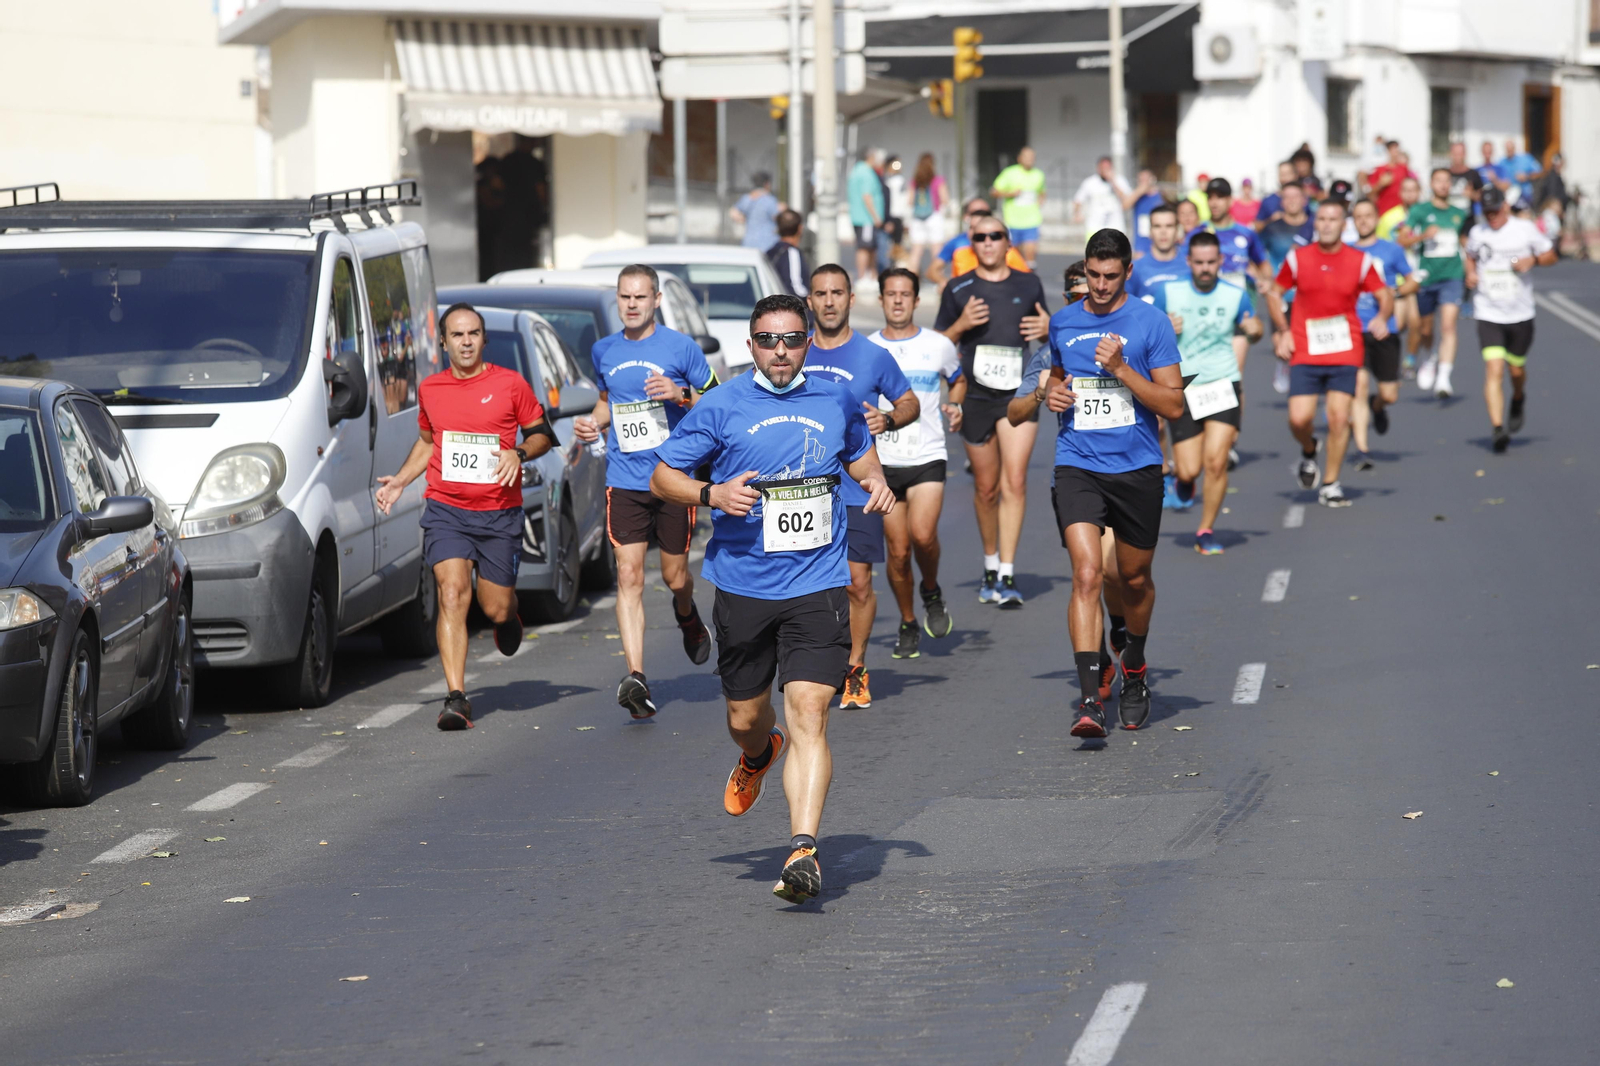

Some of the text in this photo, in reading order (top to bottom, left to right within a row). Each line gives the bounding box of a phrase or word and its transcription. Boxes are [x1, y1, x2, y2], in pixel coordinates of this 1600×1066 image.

[983, 363, 1007, 377] 246
[1083, 380, 1100, 388] VUELTA
[1084, 399, 1111, 415] 575
[622, 421, 648, 439] 506
[760, 415, 789, 427] VUELTA
[797, 415, 825, 433] HUELVA
[453, 434, 471, 443] VUELTA
[472, 435, 477, 443] A
[477, 436, 496, 445] HUELVA
[452, 453, 478, 469] 502
[778, 489, 803, 500] VUELTA
[804, 488, 809, 498] A
[810, 484, 829, 497] HUELVA
[778, 511, 814, 533] 602
